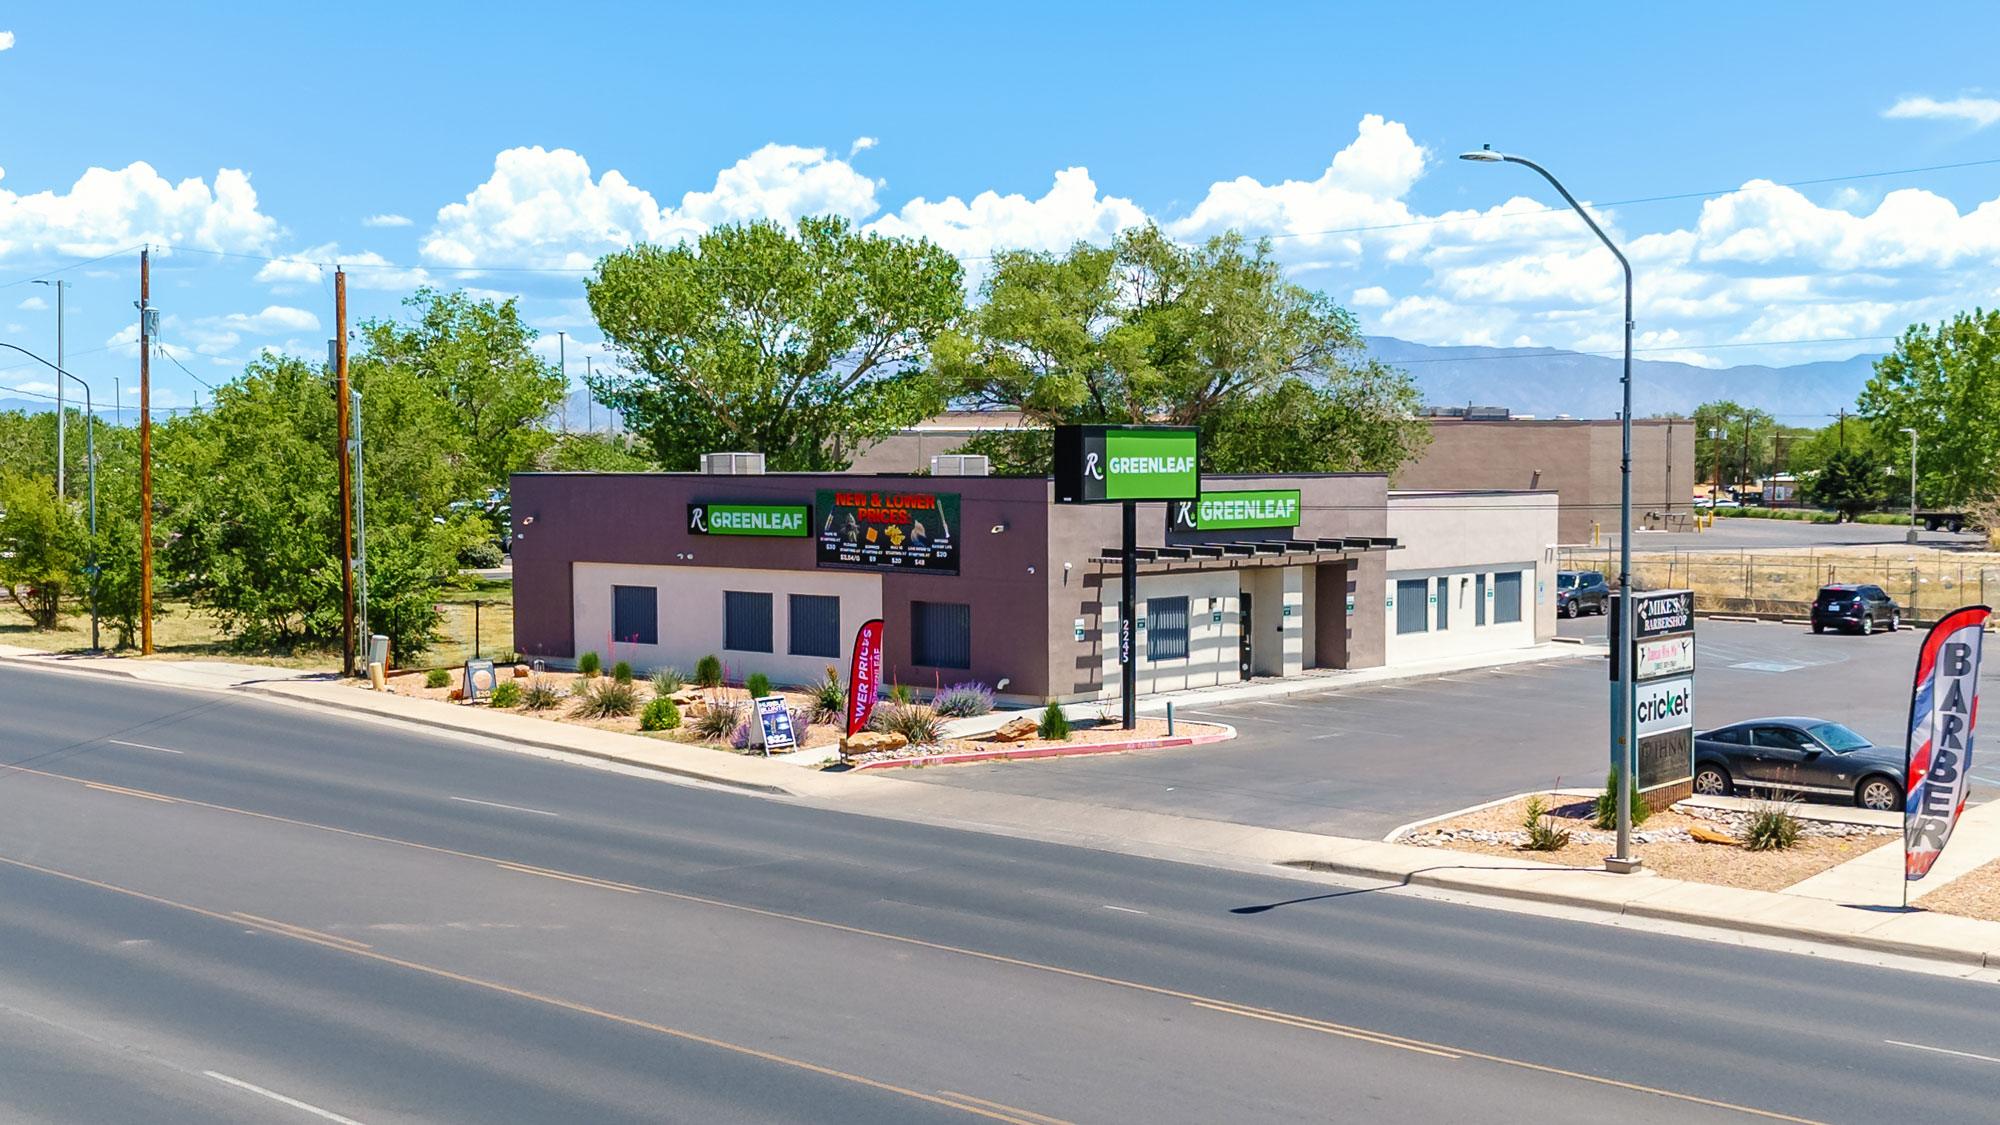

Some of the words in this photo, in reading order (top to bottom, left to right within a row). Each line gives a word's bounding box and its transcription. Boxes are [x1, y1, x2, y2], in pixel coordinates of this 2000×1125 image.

[1109, 456, 1194, 473] GREENLEAF
[835, 492, 866, 507] NEW
[871, 493, 882, 507] &
[885, 494, 935, 510] LOWER
[1200, 499, 1296, 521] GREENLEAF
[711, 512, 802, 529] GREENLEAF
[857, 507, 912, 524] PRICES:
[1648, 598, 1680, 616] MIKE'S
[1644, 615, 1687, 631] BARBERSHOP
[1638, 688, 1688, 723] cricket
[1912, 642, 1971, 850] BARBER
